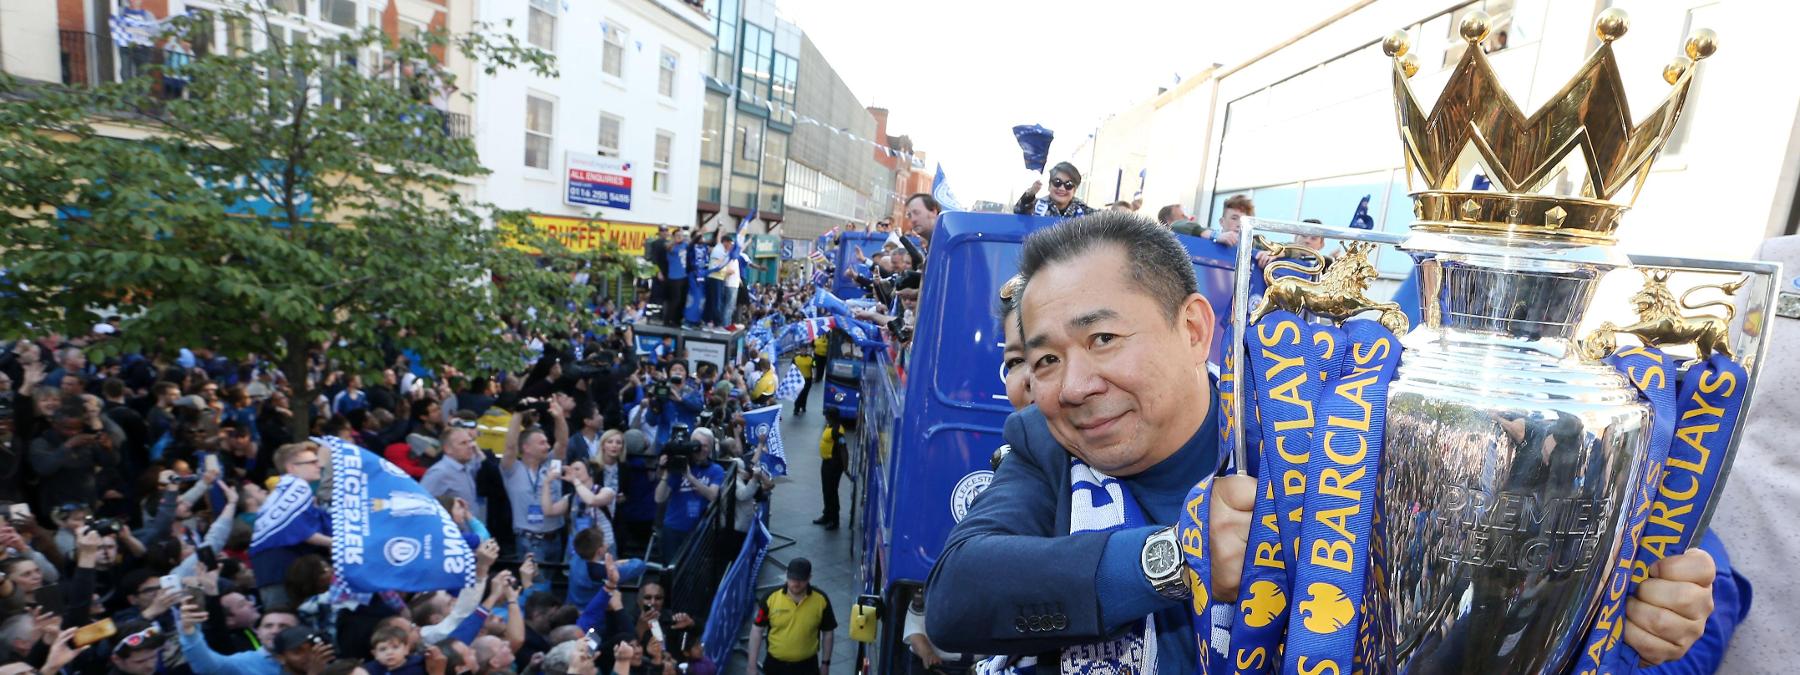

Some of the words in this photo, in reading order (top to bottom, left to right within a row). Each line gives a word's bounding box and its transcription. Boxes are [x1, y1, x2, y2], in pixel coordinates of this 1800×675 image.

[570, 170, 585, 181] ALL
[586, 172, 624, 186] ENQUIRIES
[1310, 337, 1391, 574] BARCLAYS
[1436, 483, 1615, 535] PREMIER
[1438, 527, 1602, 573] LEAGUE
